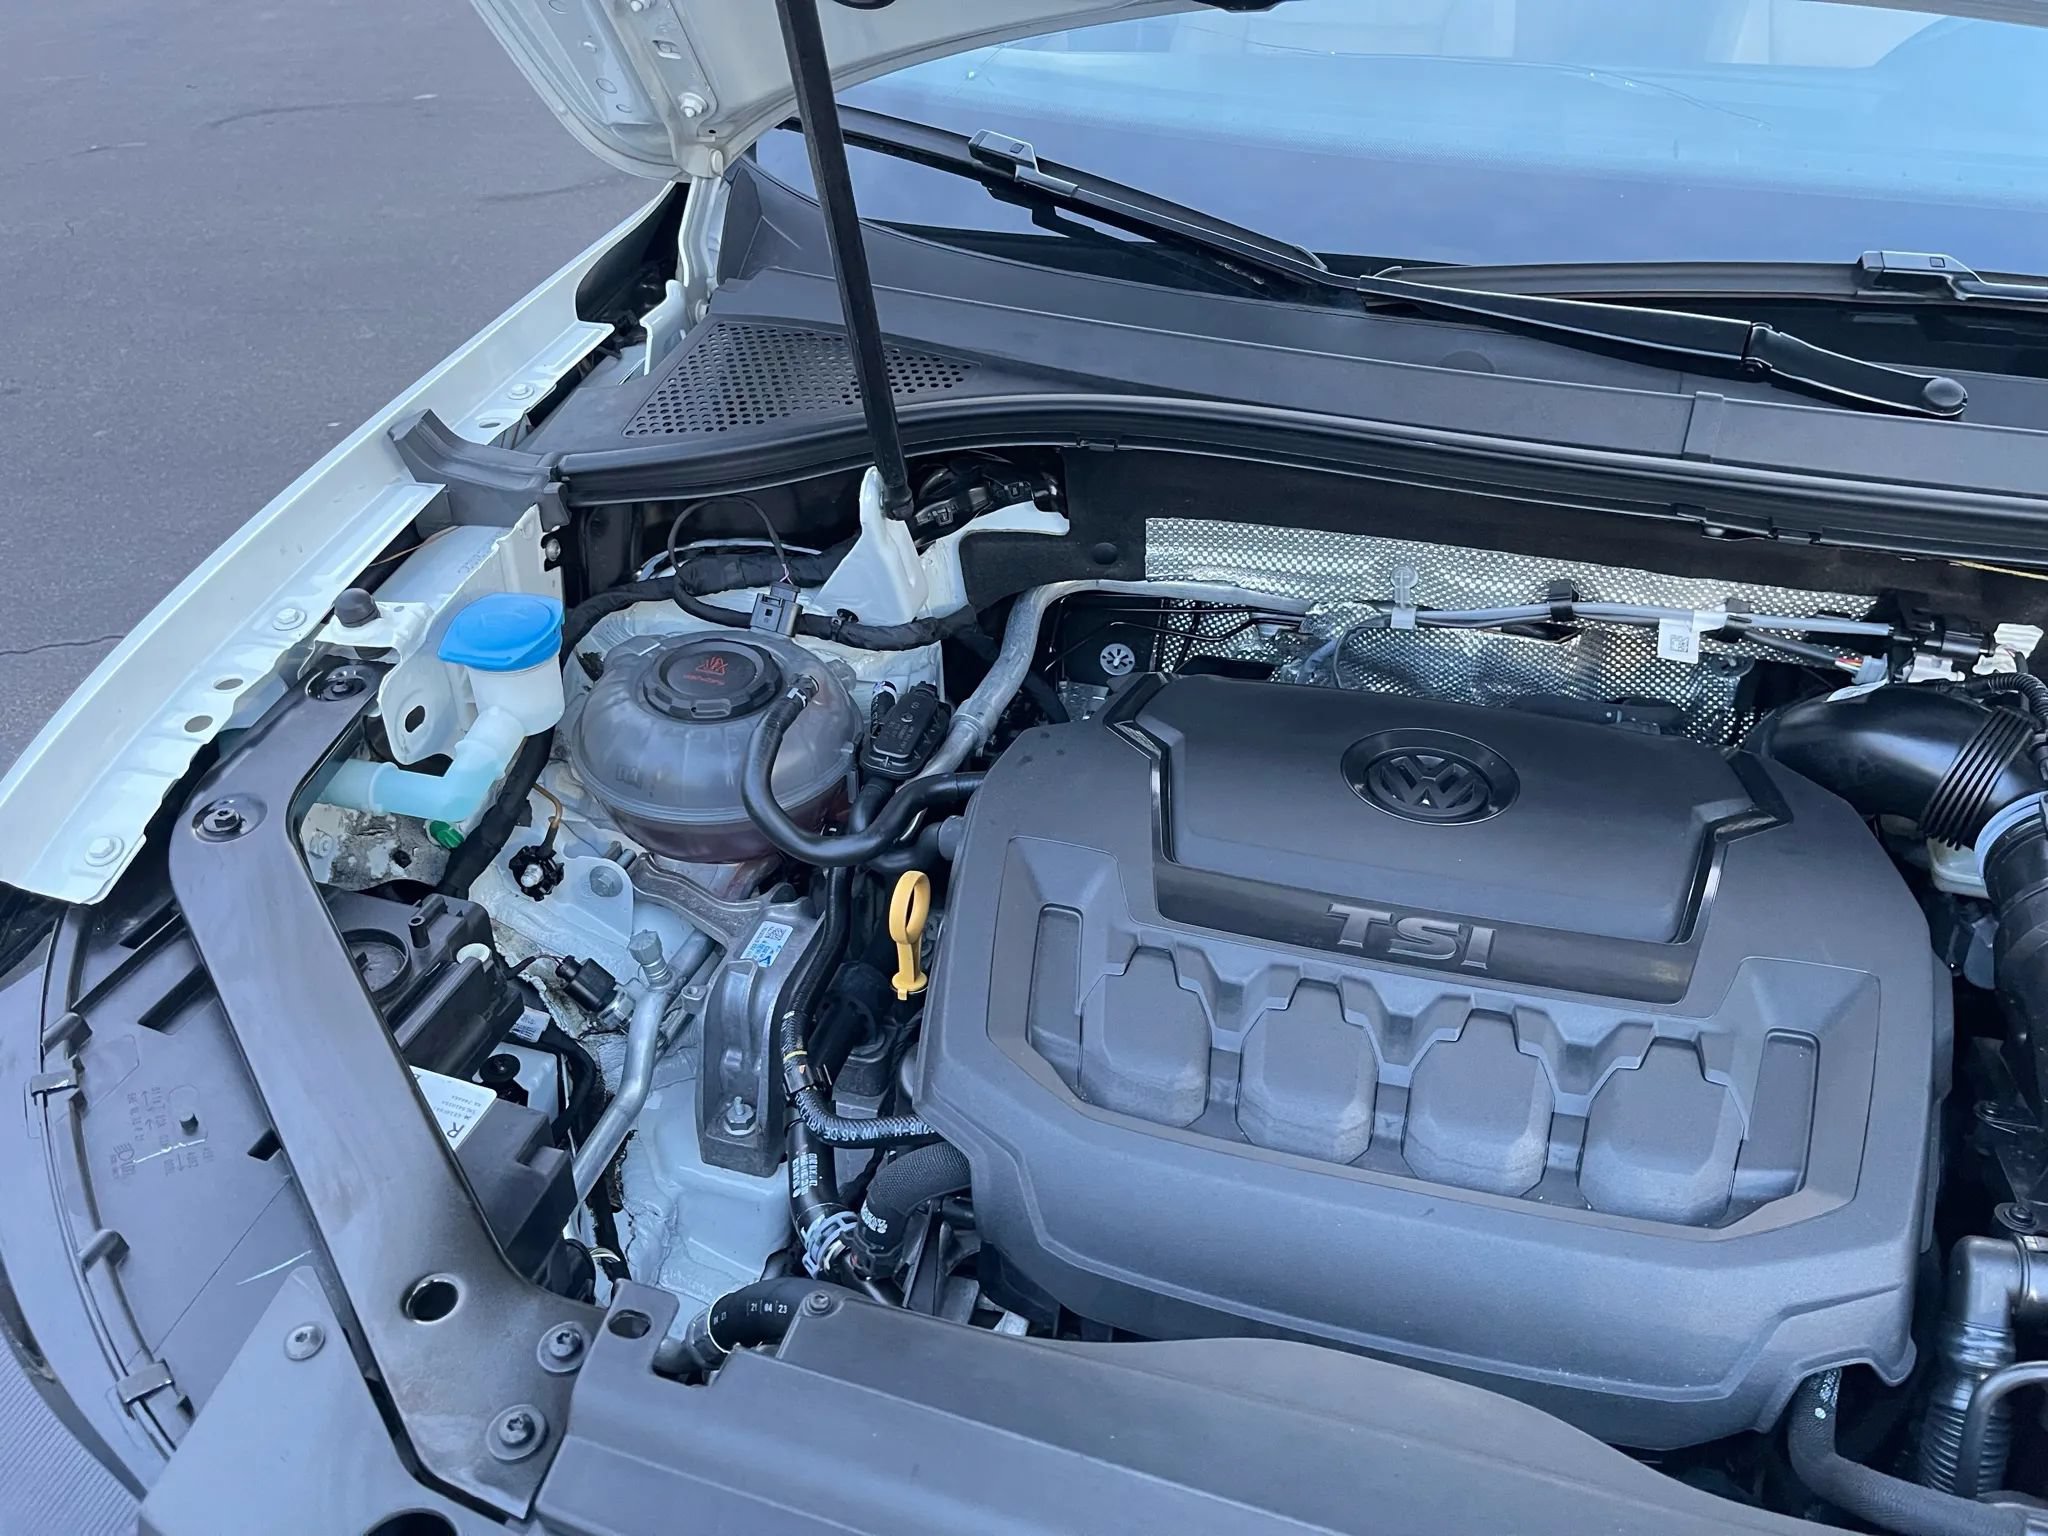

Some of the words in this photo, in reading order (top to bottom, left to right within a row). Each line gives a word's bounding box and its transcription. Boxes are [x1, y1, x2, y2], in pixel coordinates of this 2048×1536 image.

[1370, 749, 1487, 817] VW
[1326, 902, 1496, 970] TSI
[447, 1121, 465, 1139] R
